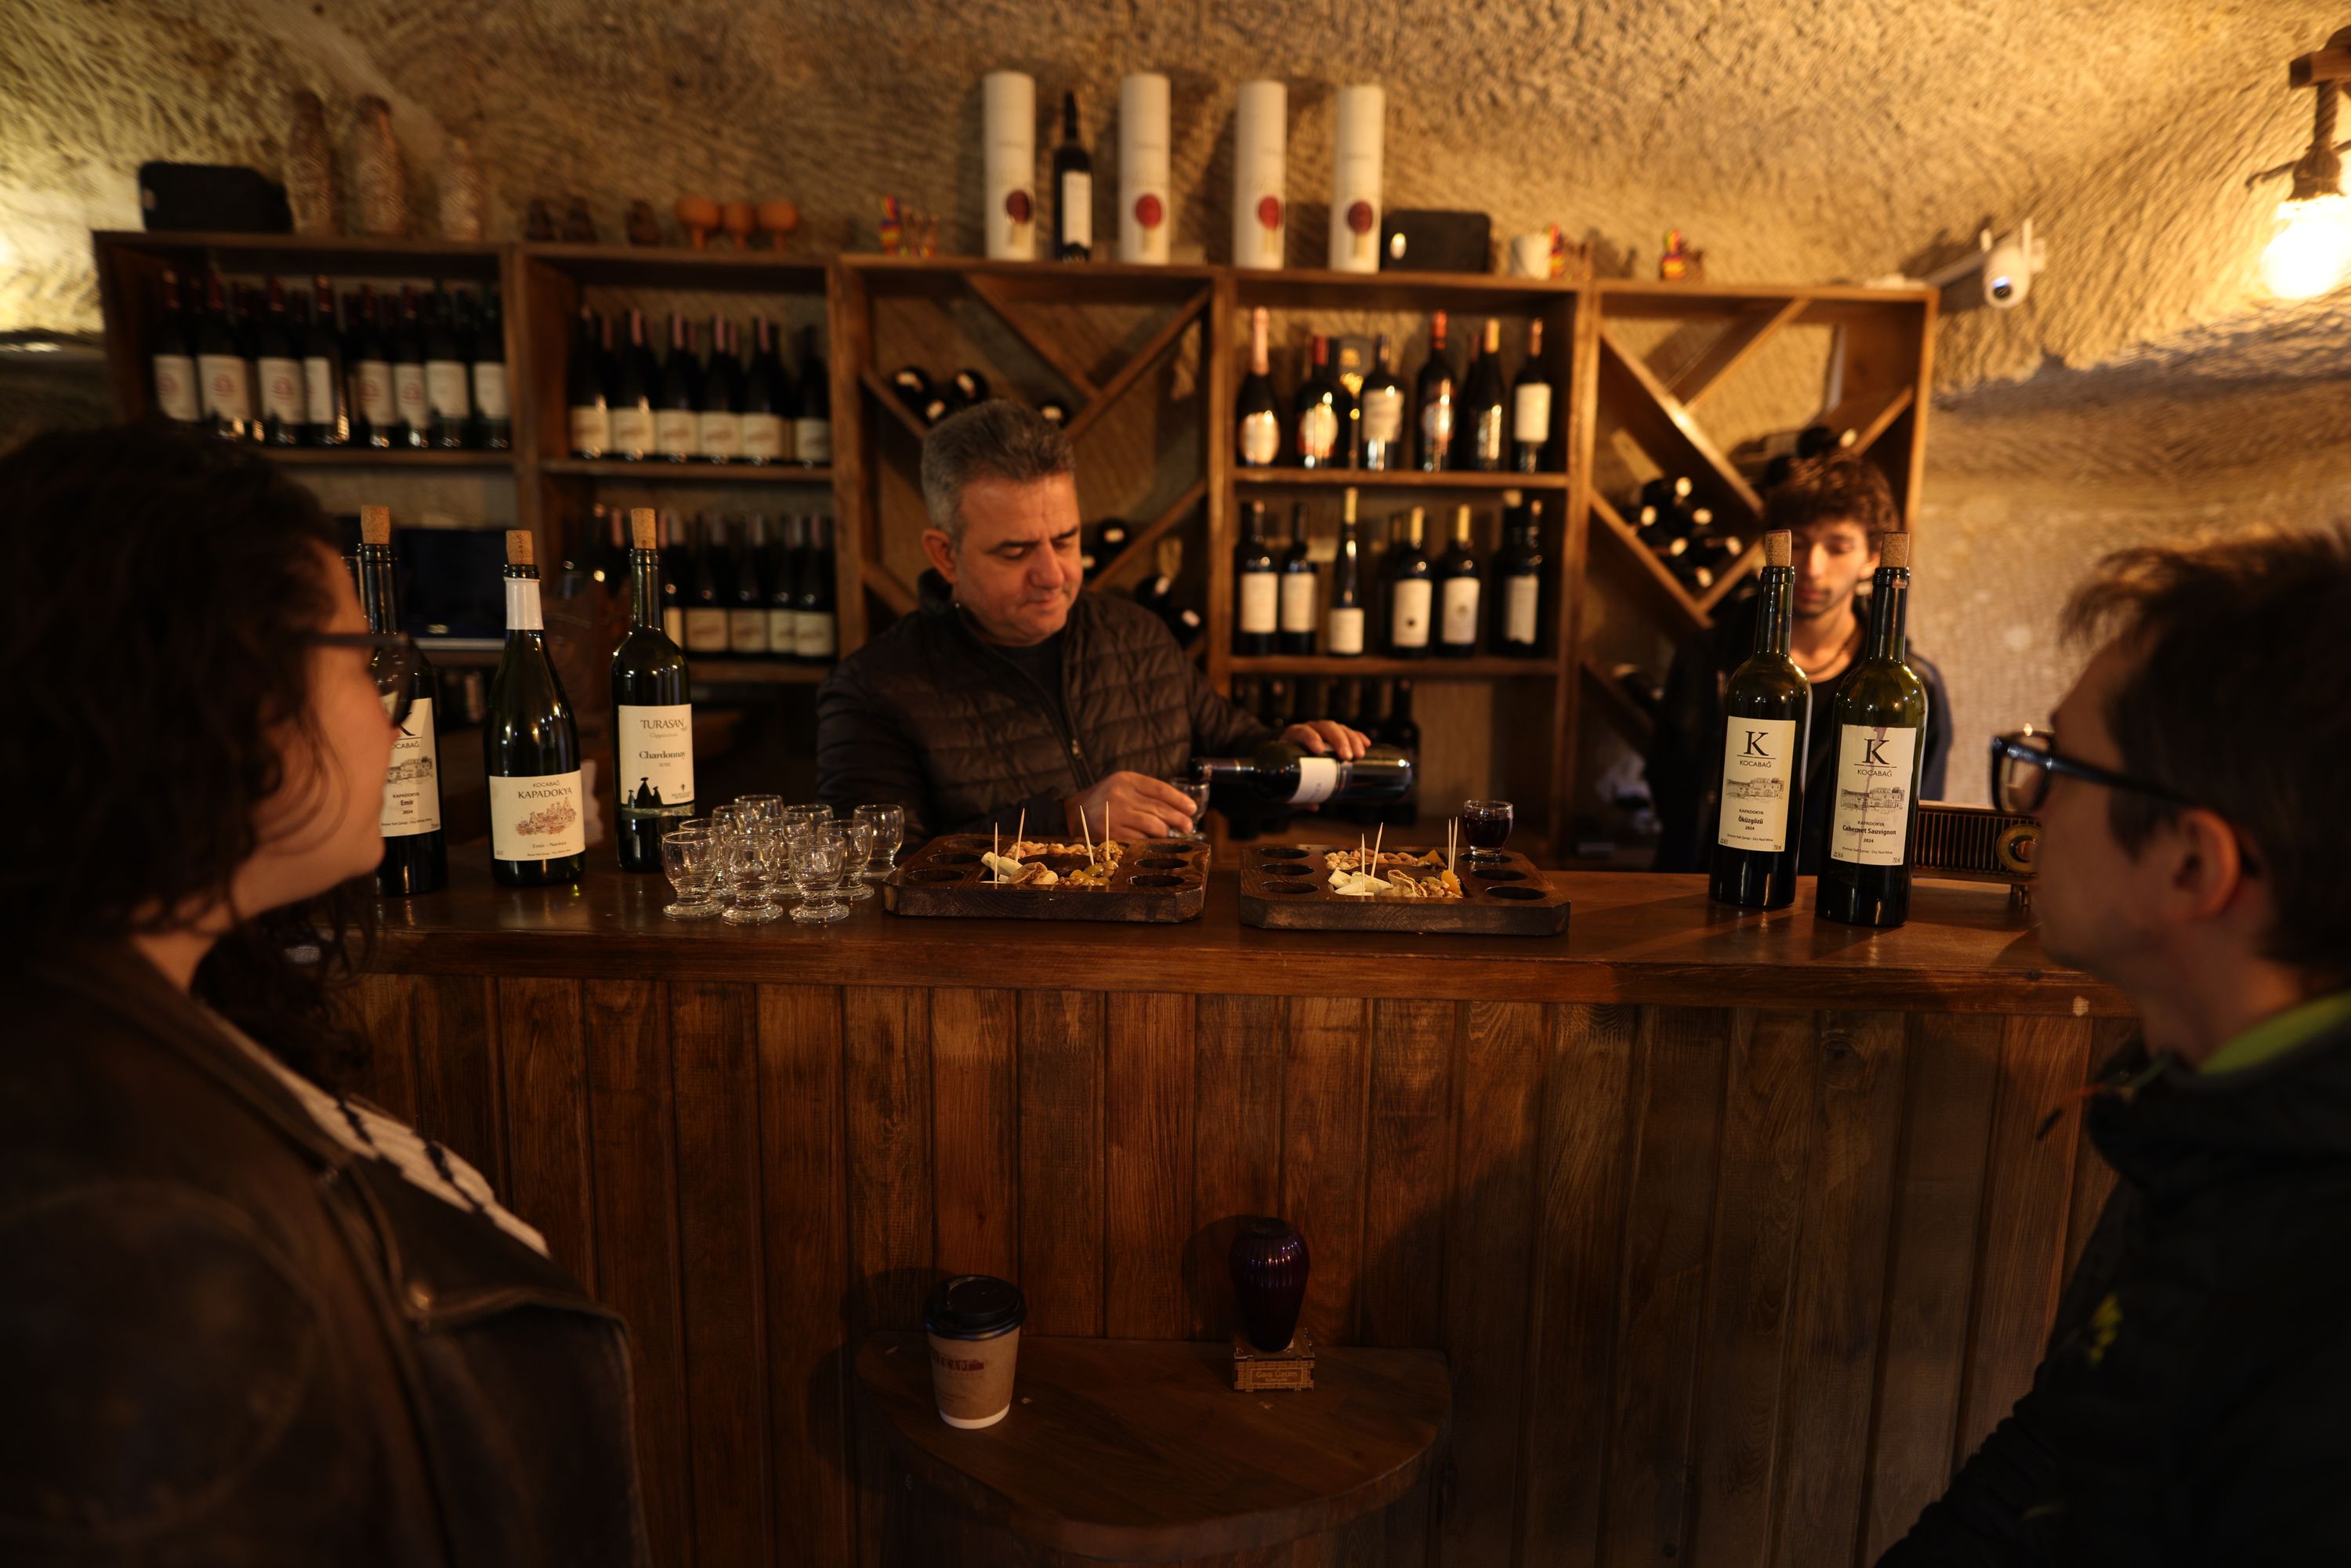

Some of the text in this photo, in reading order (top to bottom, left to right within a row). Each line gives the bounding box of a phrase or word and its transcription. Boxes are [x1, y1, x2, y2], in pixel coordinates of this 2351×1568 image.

[640, 719, 684, 729] TURASAN
[1744, 731, 1769, 756] K
[639, 751, 686, 759] Chardonnay
[1862, 738, 1890, 765] K
[1740, 759, 1772, 768] KOCABAĞ
[1857, 769, 1893, 777] KOCABAĞ
[518, 788, 572, 799] KAPADOKYA
[1738, 816, 1763, 824] Öküzgözü
[1842, 824, 1867, 834] Cabernet
